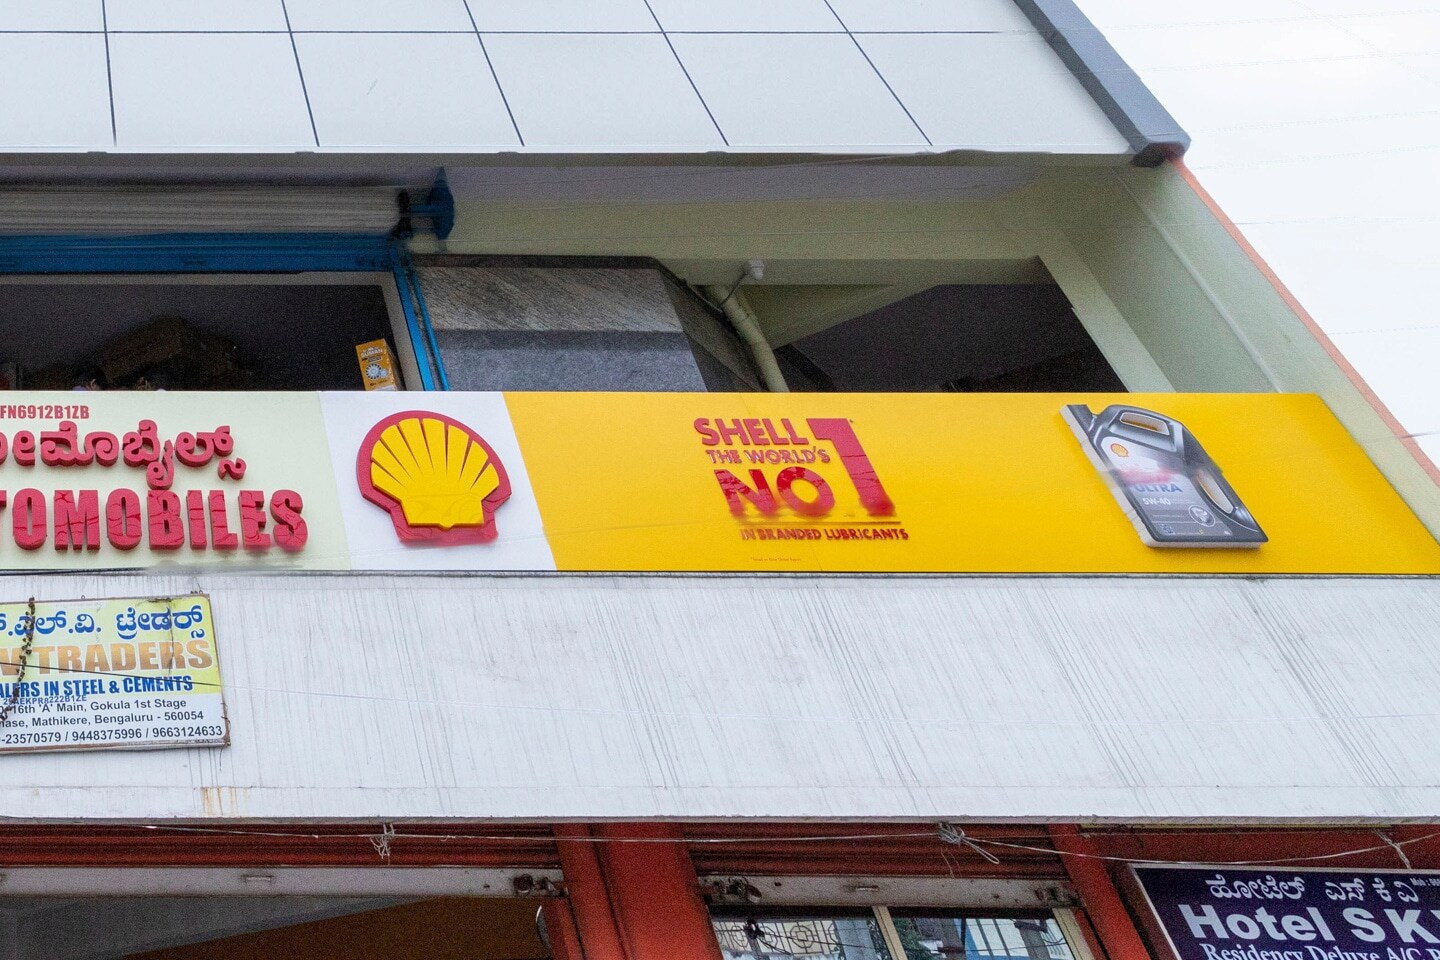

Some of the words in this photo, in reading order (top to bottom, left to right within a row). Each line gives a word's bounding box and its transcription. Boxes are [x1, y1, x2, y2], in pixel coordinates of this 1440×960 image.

[694, 417, 809, 446] SHELL
[705, 449, 742, 464] THE
[743, 446, 831, 464] WORLD'S
[806, 418, 896, 518] 1
[740, 528, 756, 540] IN
[757, 528, 822, 540] BRANDED
[824, 528, 909, 540] LUBRICANTS
[32, 639, 213, 675] TRADERS
[44, 680, 60, 697] IN
[63, 678, 106, 697] STEEL
[109, 680, 120, 694] &
[123, 675, 193, 693] CEMENTS
[13, 704, 36, 715] 16th
[56, 702, 87, 713] Main,
[90, 700, 131, 711] Gokula
[134, 699, 151, 709] 1st
[154, 698, 187, 710] Stage
[32, 715, 91, 727] Mathikere,
[94, 713, 154, 725] Bengaluru
[164, 711, 204, 721] 560054
[71, 728, 142, 741] 9448375996
[152, 725, 223, 738] 9663124633
[1178, 904, 1336, 941] Hotel
